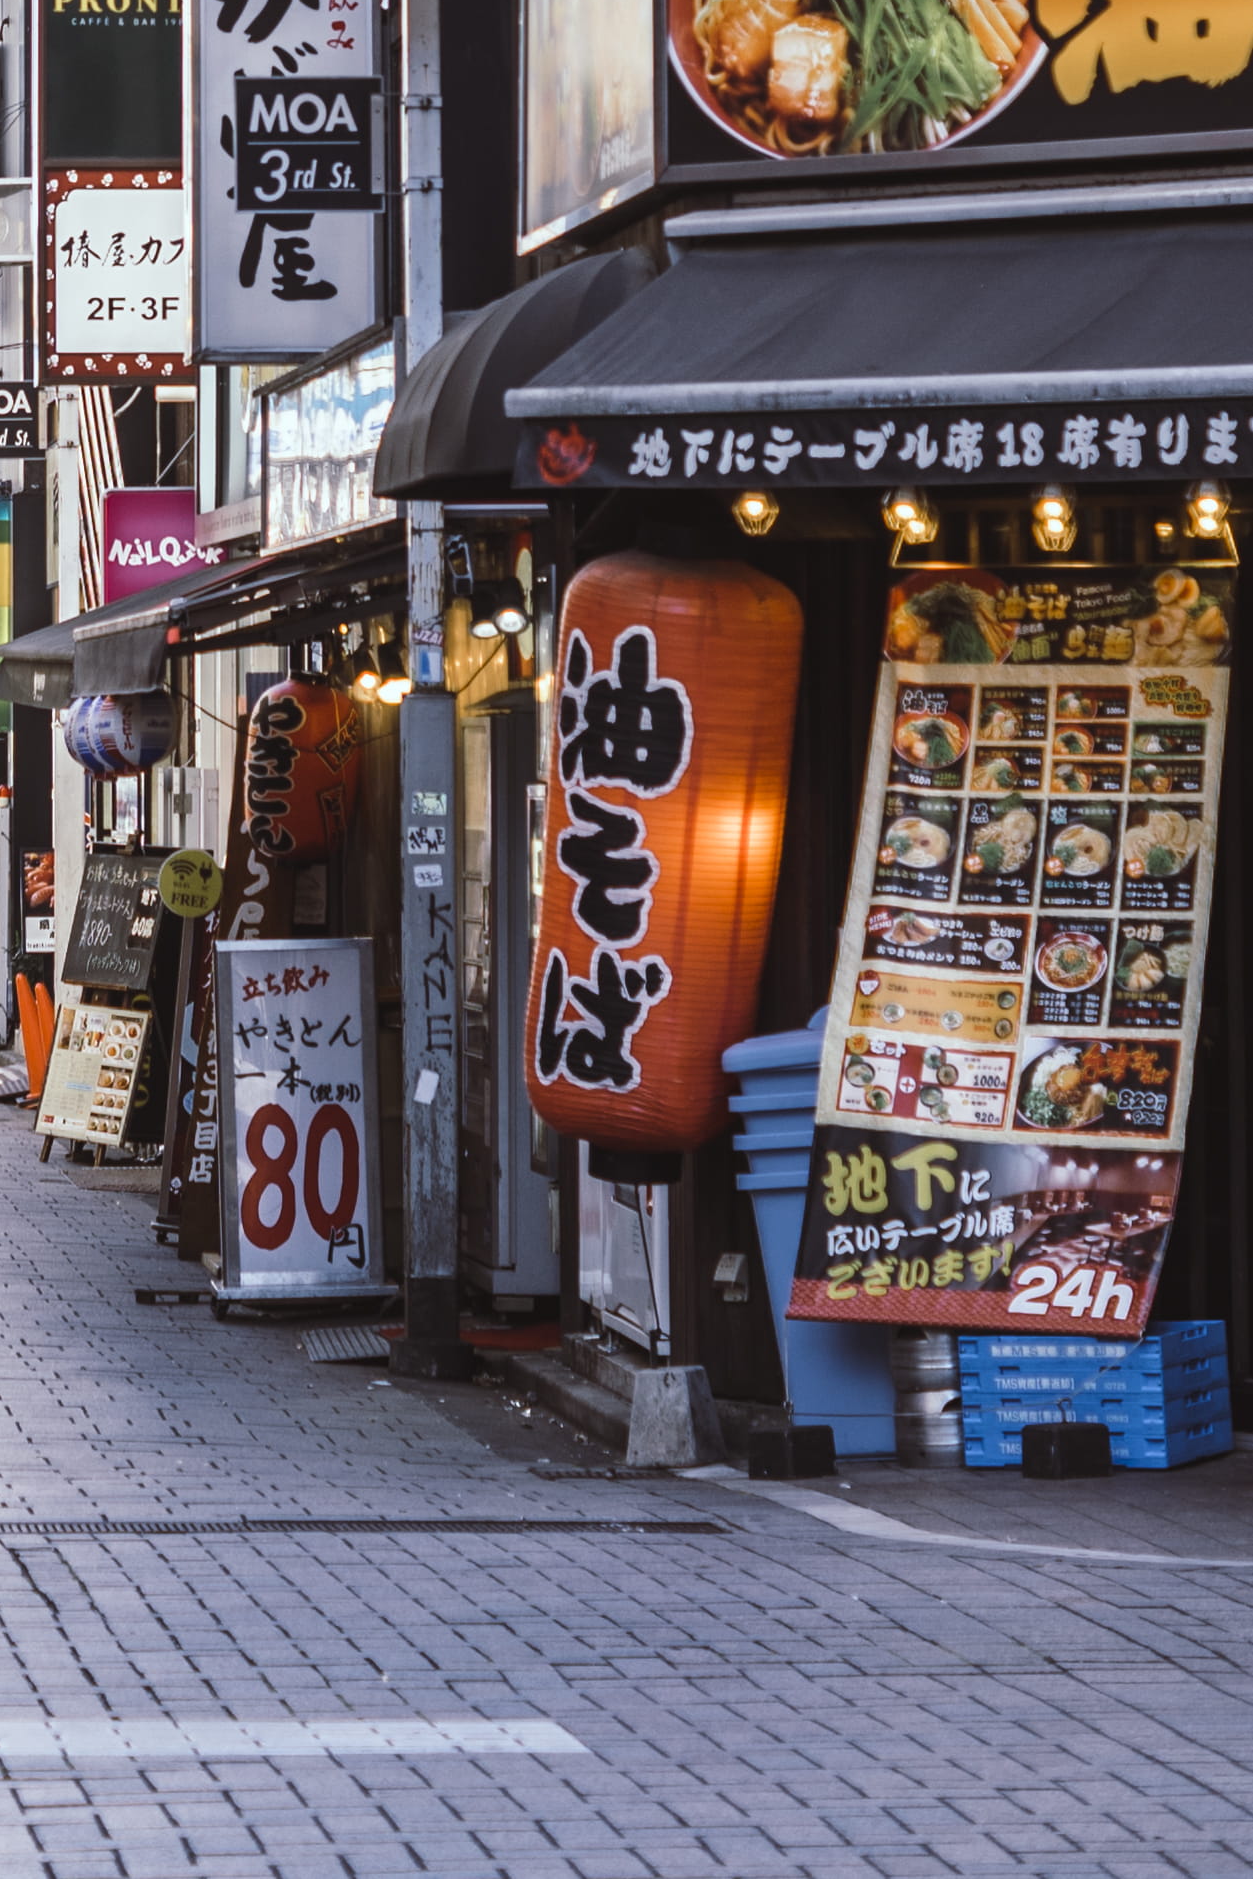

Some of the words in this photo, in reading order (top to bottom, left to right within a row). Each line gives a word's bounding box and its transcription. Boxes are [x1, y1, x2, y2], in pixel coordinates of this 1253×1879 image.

[118, 17, 125, 26] &
[249, 93, 358, 133] MOA
[254, 149, 317, 202] 3rd
[331, 163, 356, 189] St.
[87, 297, 180, 321] 2F・3F
[14, 430, 31, 447] St.
[536, 625, 695, 1094] 油そば
[170, 893, 209, 909] FREE
[242, 965, 331, 1002] 立ち飲み
[233, 1014, 363, 1050] やきとん
[240, 1103, 360, 1251] 80
[822, 1141, 992, 1217] 地下に
[327, 1223, 367, 1269] 円
[825, 1206, 1016, 1257] 広いテーブル席
[825, 1242, 1016, 1301] ございます!
[1007, 1265, 1137, 1321] 24h
